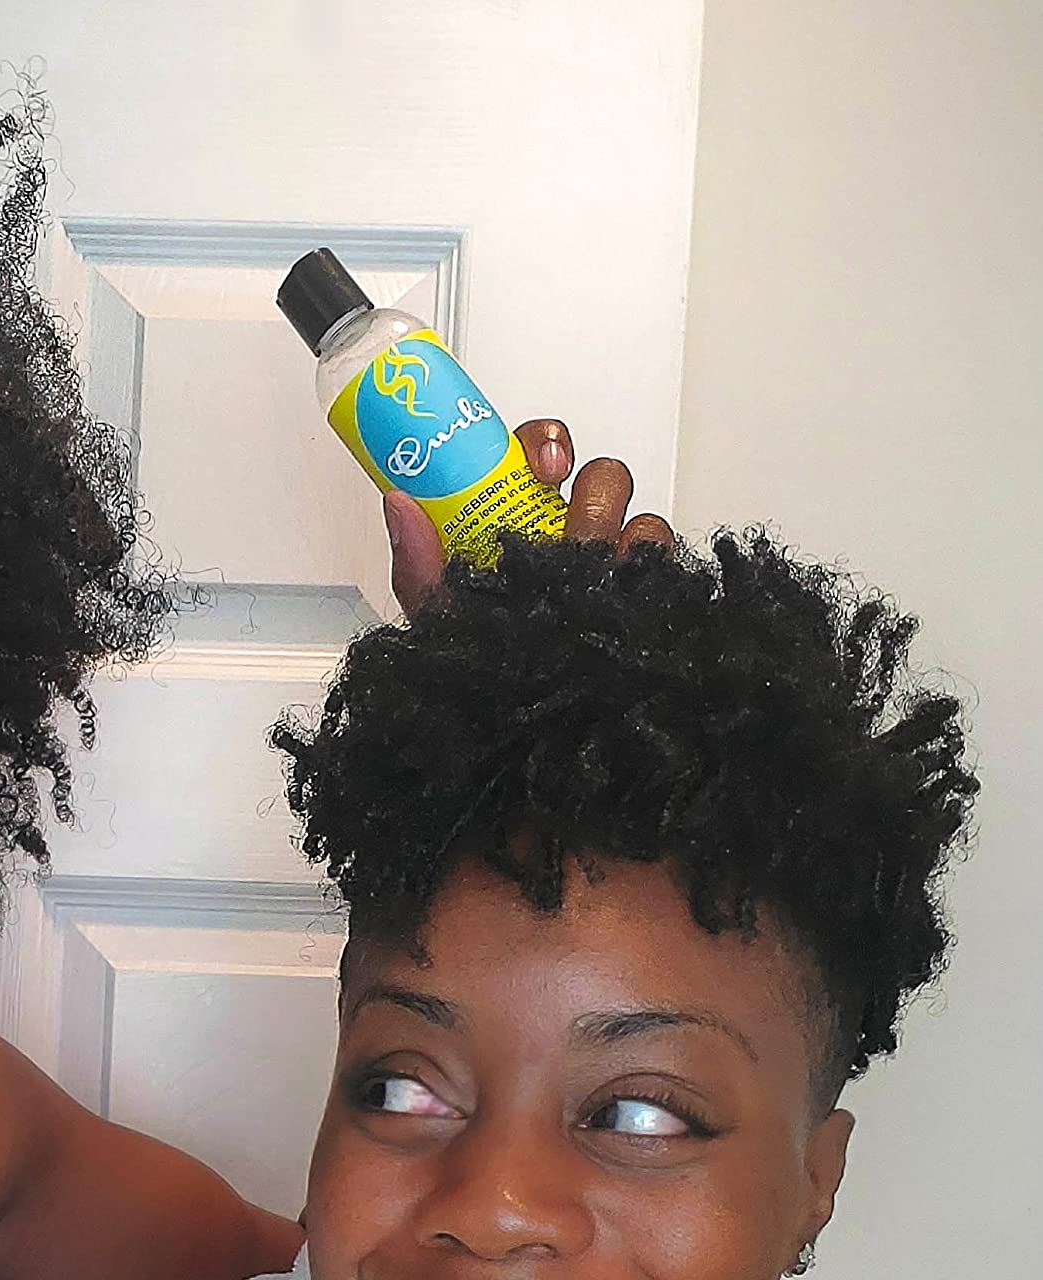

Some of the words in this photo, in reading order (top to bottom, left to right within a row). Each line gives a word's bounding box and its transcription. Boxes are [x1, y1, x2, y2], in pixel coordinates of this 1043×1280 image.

[443, 475, 510, 536] BLUEBERRY
[478, 496, 508, 520] leave
[506, 488, 519, 498] in
